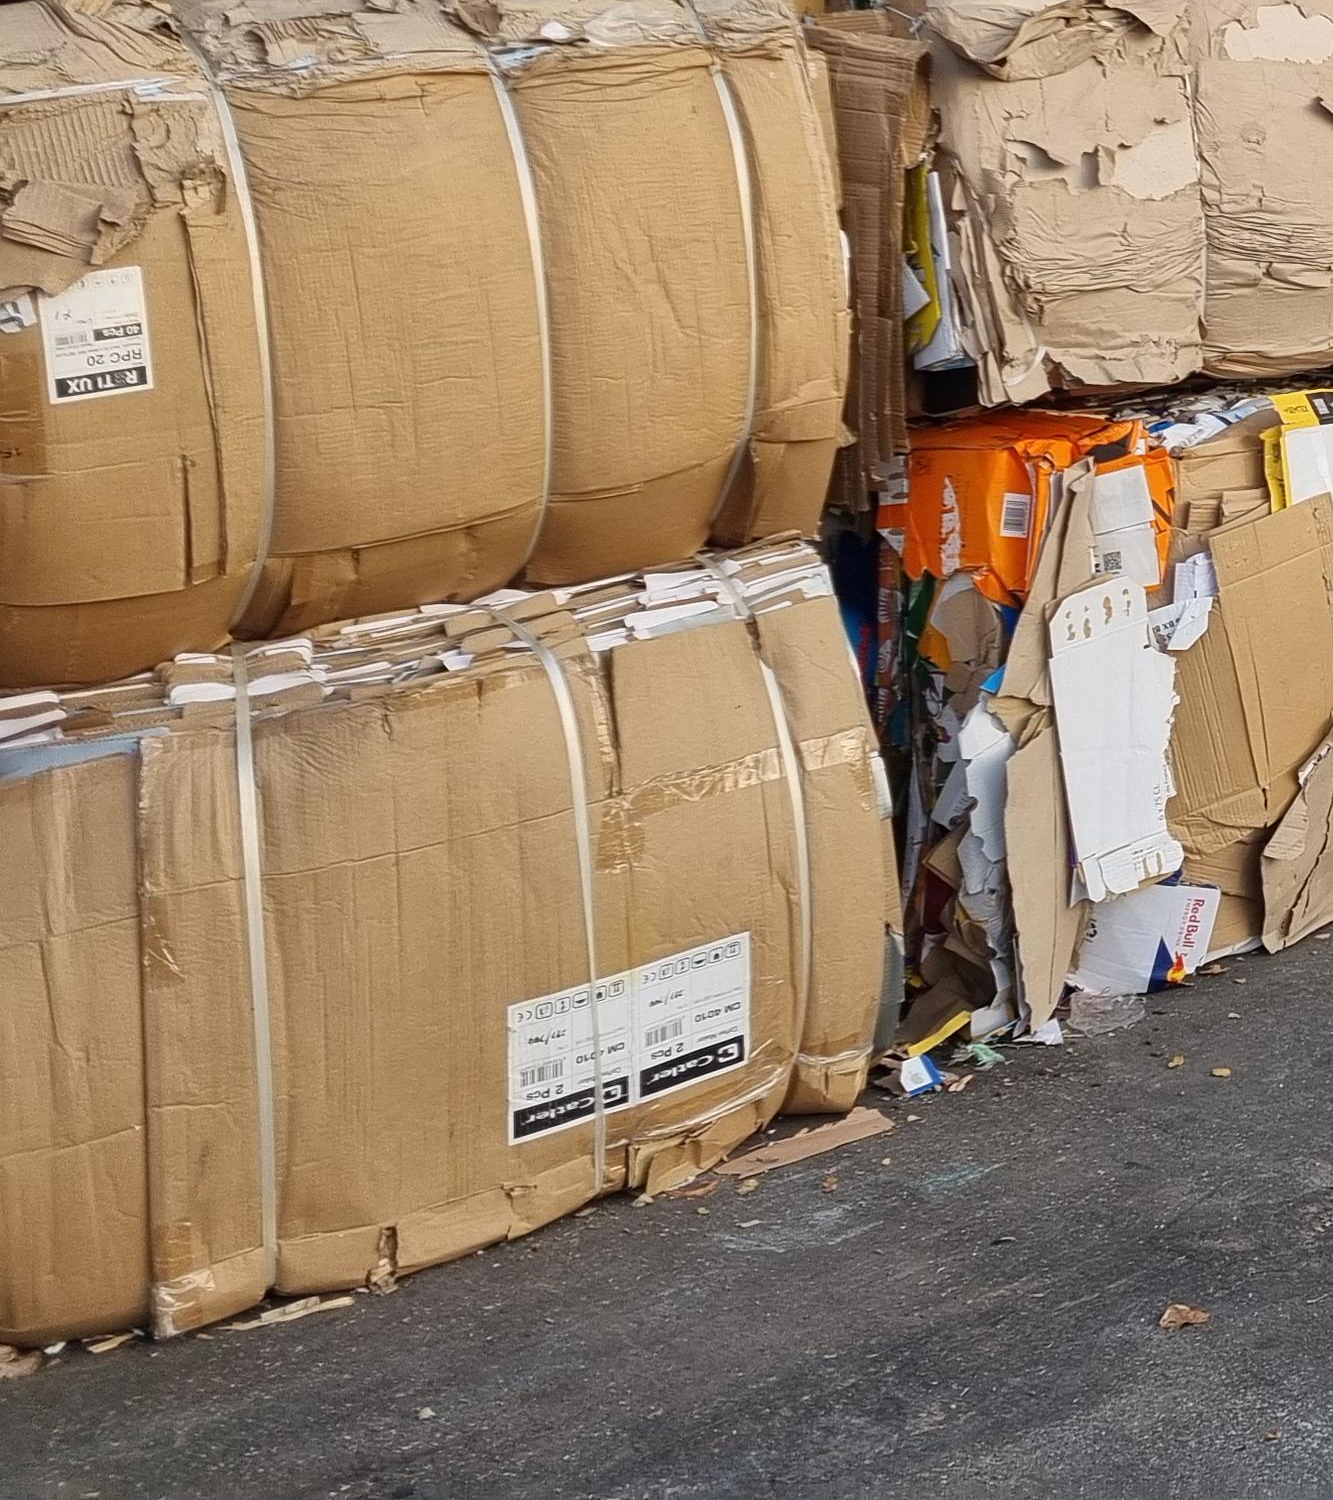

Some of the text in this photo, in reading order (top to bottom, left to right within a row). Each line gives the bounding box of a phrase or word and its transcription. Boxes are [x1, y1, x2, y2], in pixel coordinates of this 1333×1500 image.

[87, 348, 142, 367] RPC 20
[1182, 898, 1205, 948] Red Bull
[695, 1001, 741, 1023] CM 4010
[607, 1041, 625, 1055] CM
[650, 1043, 684, 1061] 2 Pcs
[650, 1055, 714, 1084] Catler
[526, 1084, 564, 1101] 2 Pcs
[523, 1097, 596, 1124] Catler
